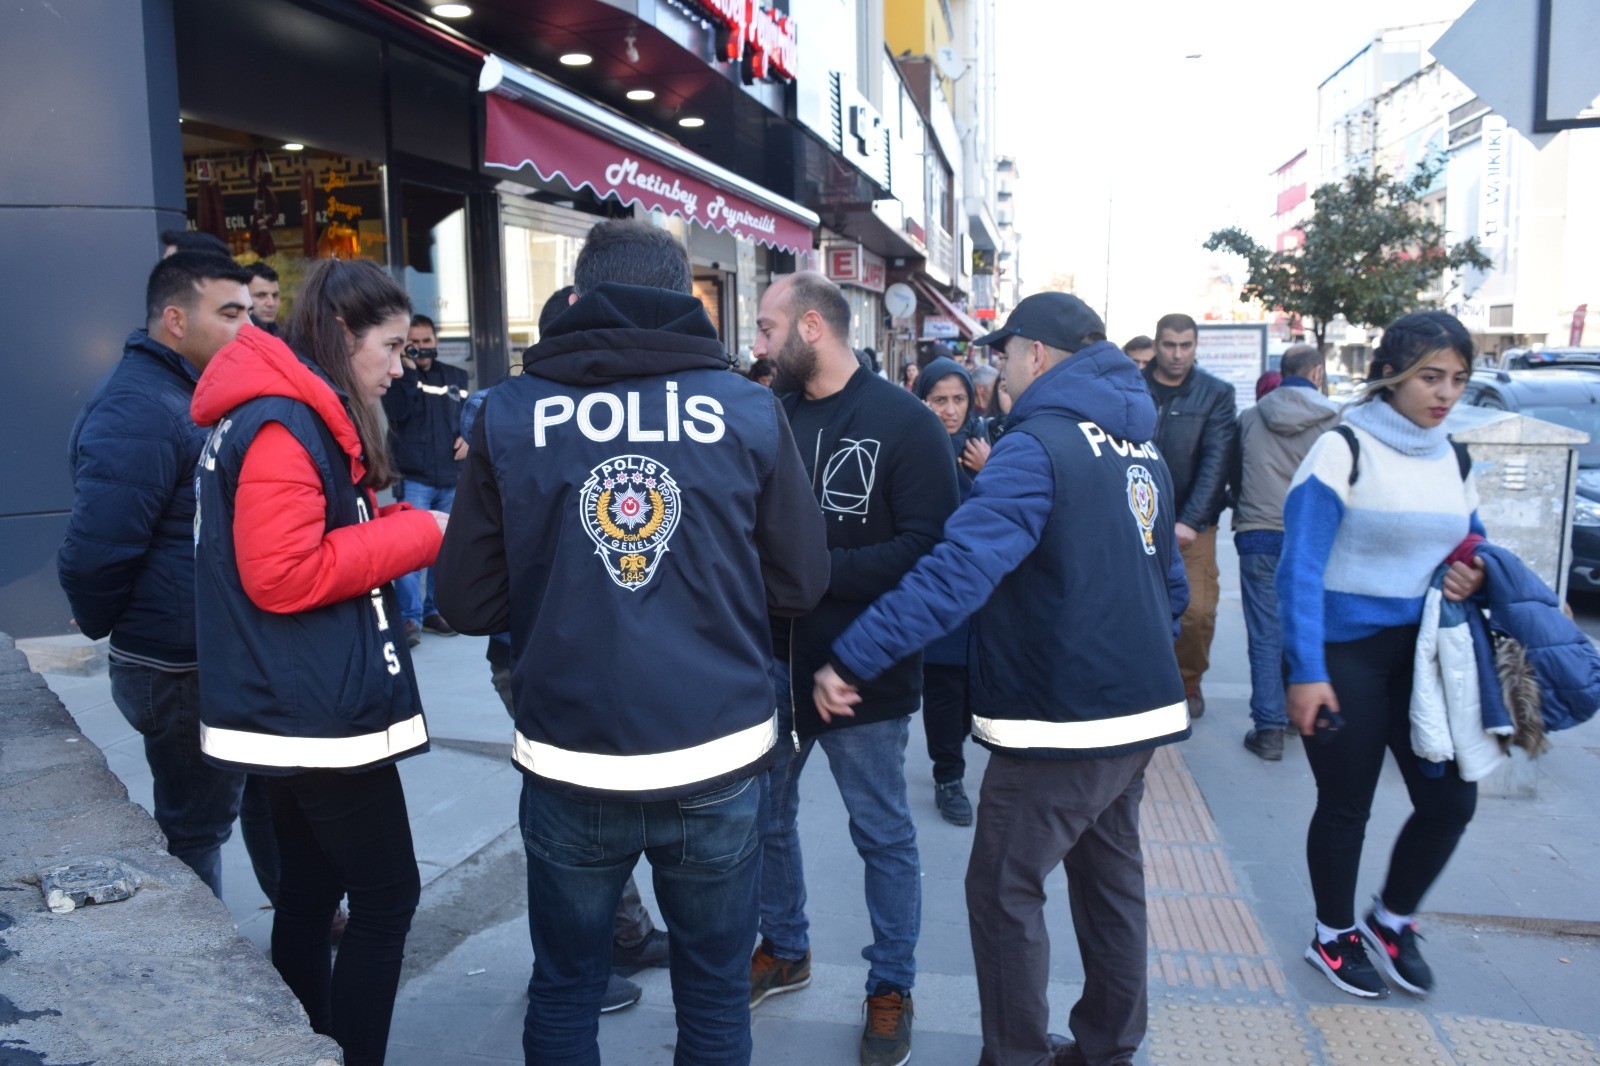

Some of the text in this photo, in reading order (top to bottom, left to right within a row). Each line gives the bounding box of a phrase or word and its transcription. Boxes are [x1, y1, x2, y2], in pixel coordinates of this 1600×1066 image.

[605, 157, 776, 234] Metinbey Peynircilik
[833, 252, 853, 275] E
[533, 380, 726, 447] POLİS
[601, 457, 657, 478] POLİS
[611, 540, 651, 552] GENEL
[623, 534, 641, 542] EGM
[620, 571, 645, 583] 1845
